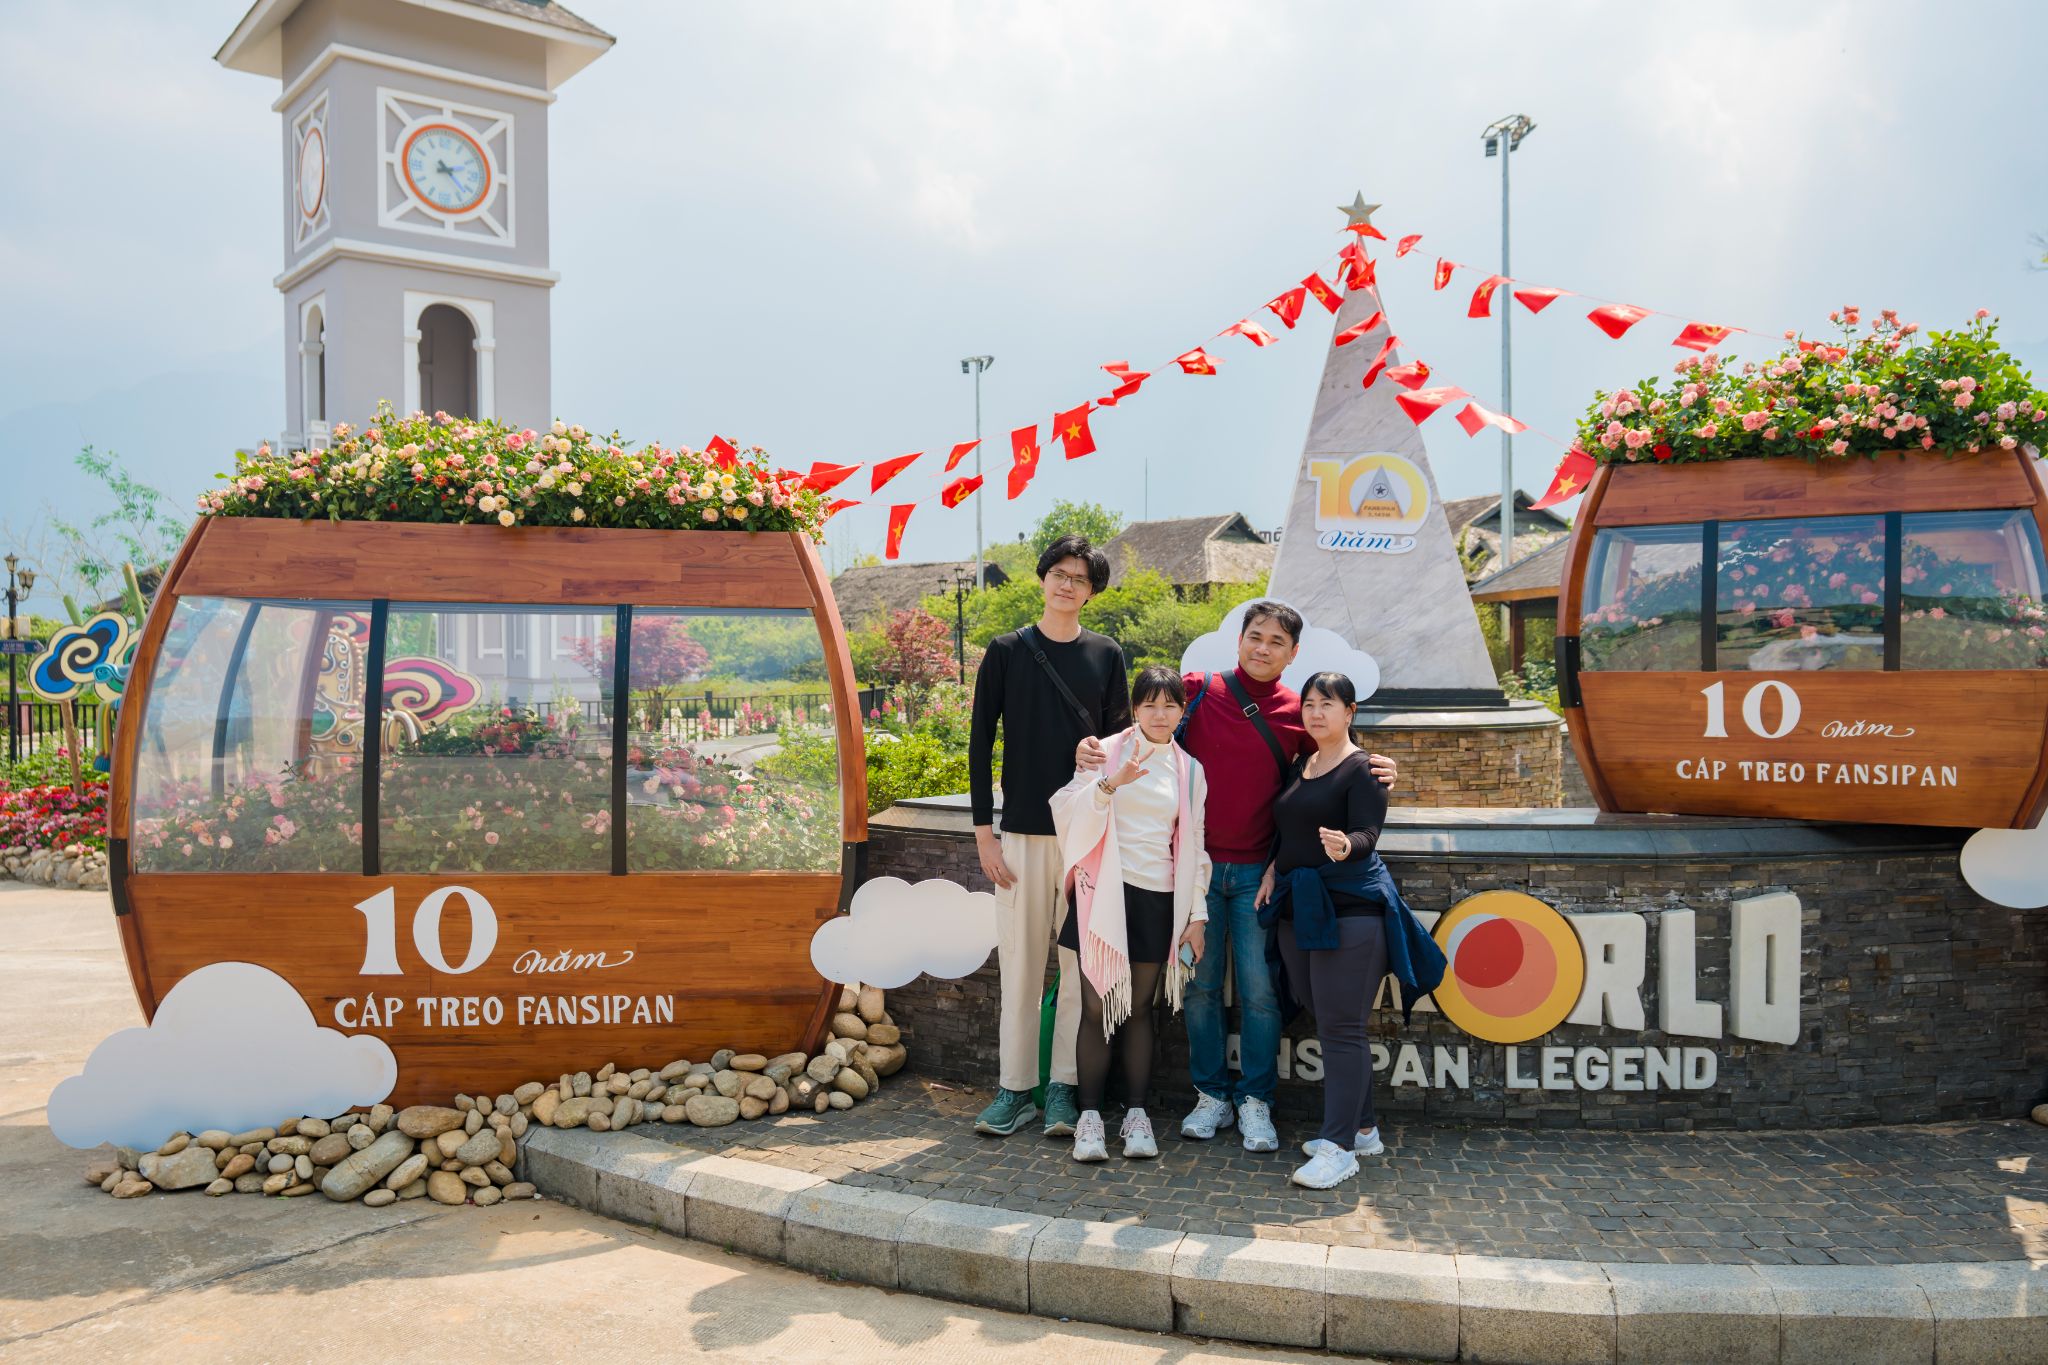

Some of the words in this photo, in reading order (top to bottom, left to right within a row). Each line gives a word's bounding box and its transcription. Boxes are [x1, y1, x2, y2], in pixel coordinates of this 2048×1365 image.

[1310, 454, 1428, 522] 10
[1700, 679, 1802, 739] 10
[1676, 756, 1727, 780] CÁP
[1738, 761, 1805, 782] TREO
[1817, 763, 1957, 786] FANSIPAN
[353, 885, 499, 975] 10
[334, 992, 404, 1028] CÁP
[417, 997, 504, 1027] TREO
[518, 995, 674, 1025] FANSIPAN
[1505, 1045, 1719, 1091] LEGEND
